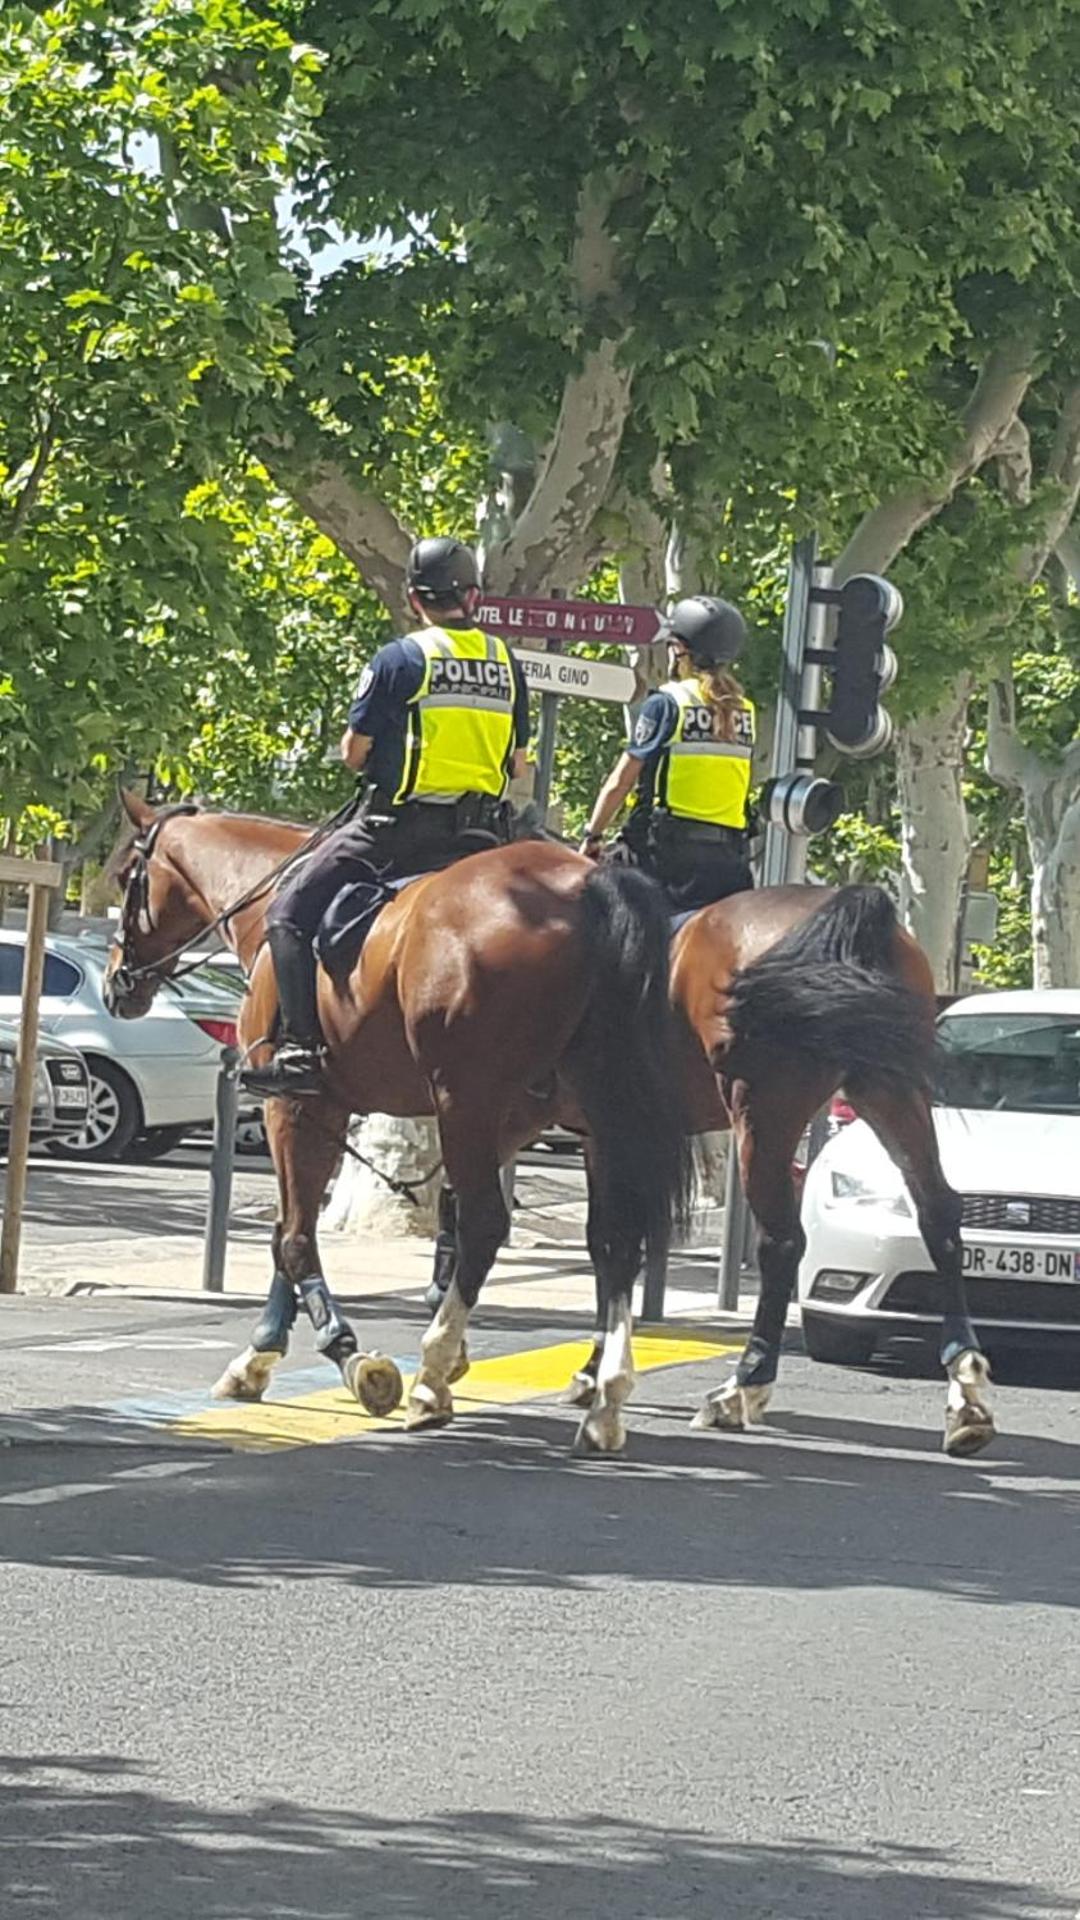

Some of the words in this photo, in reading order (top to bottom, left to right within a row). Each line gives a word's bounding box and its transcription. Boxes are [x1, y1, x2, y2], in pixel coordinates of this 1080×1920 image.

[509, 607, 523, 626] LE
[431, 659, 511, 687] POLICE
[558, 666, 589, 686] GINO
[683, 707, 752, 735] POCE
[961, 1246, 1072, 1277] DR-438-DN
